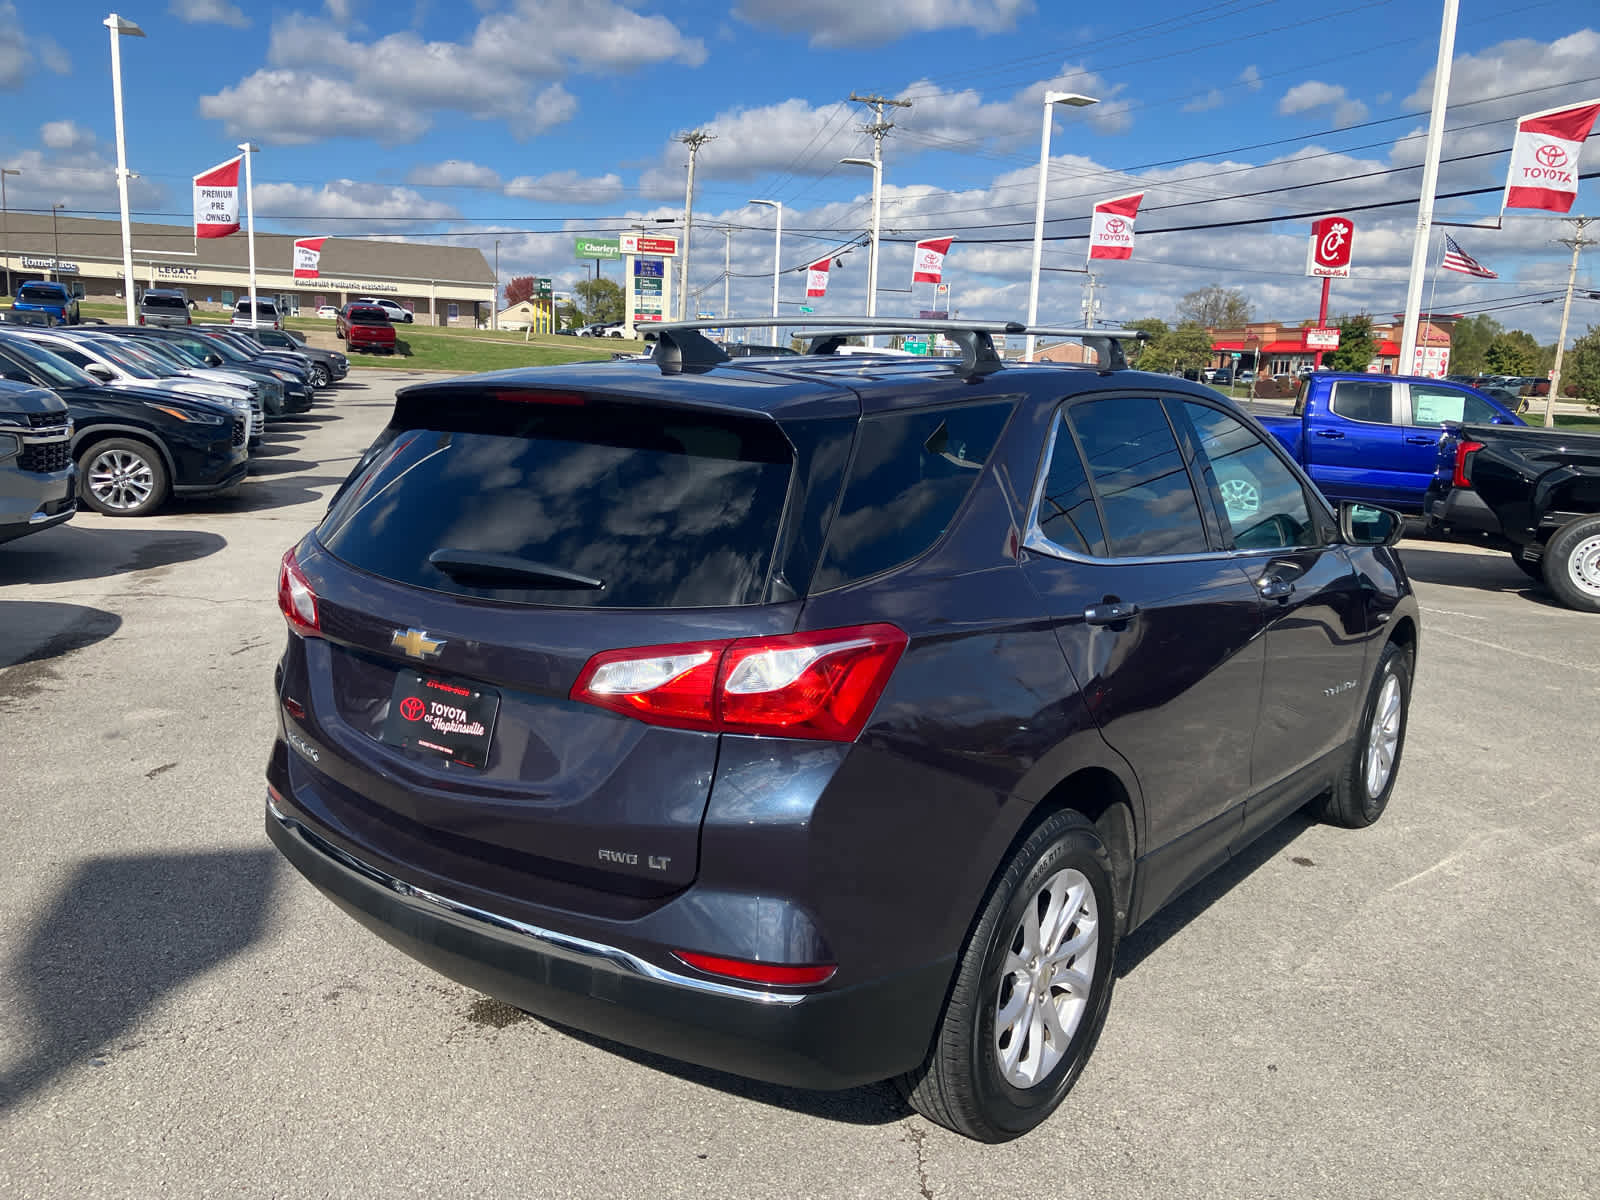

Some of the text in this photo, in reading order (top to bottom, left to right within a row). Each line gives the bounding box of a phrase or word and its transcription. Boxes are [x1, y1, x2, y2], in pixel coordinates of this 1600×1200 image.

[1523, 167, 1572, 183] TOYOTA
[211, 202, 225, 210] PRE
[206, 213, 231, 222] OWNED
[1099, 233, 1130, 241] TOYOTA
[158, 265, 198, 275] LEGACY
[431, 702, 467, 722] TOYOTA
[424, 714, 485, 735] OF Hopkinsville
[648, 855, 672, 872] LT
